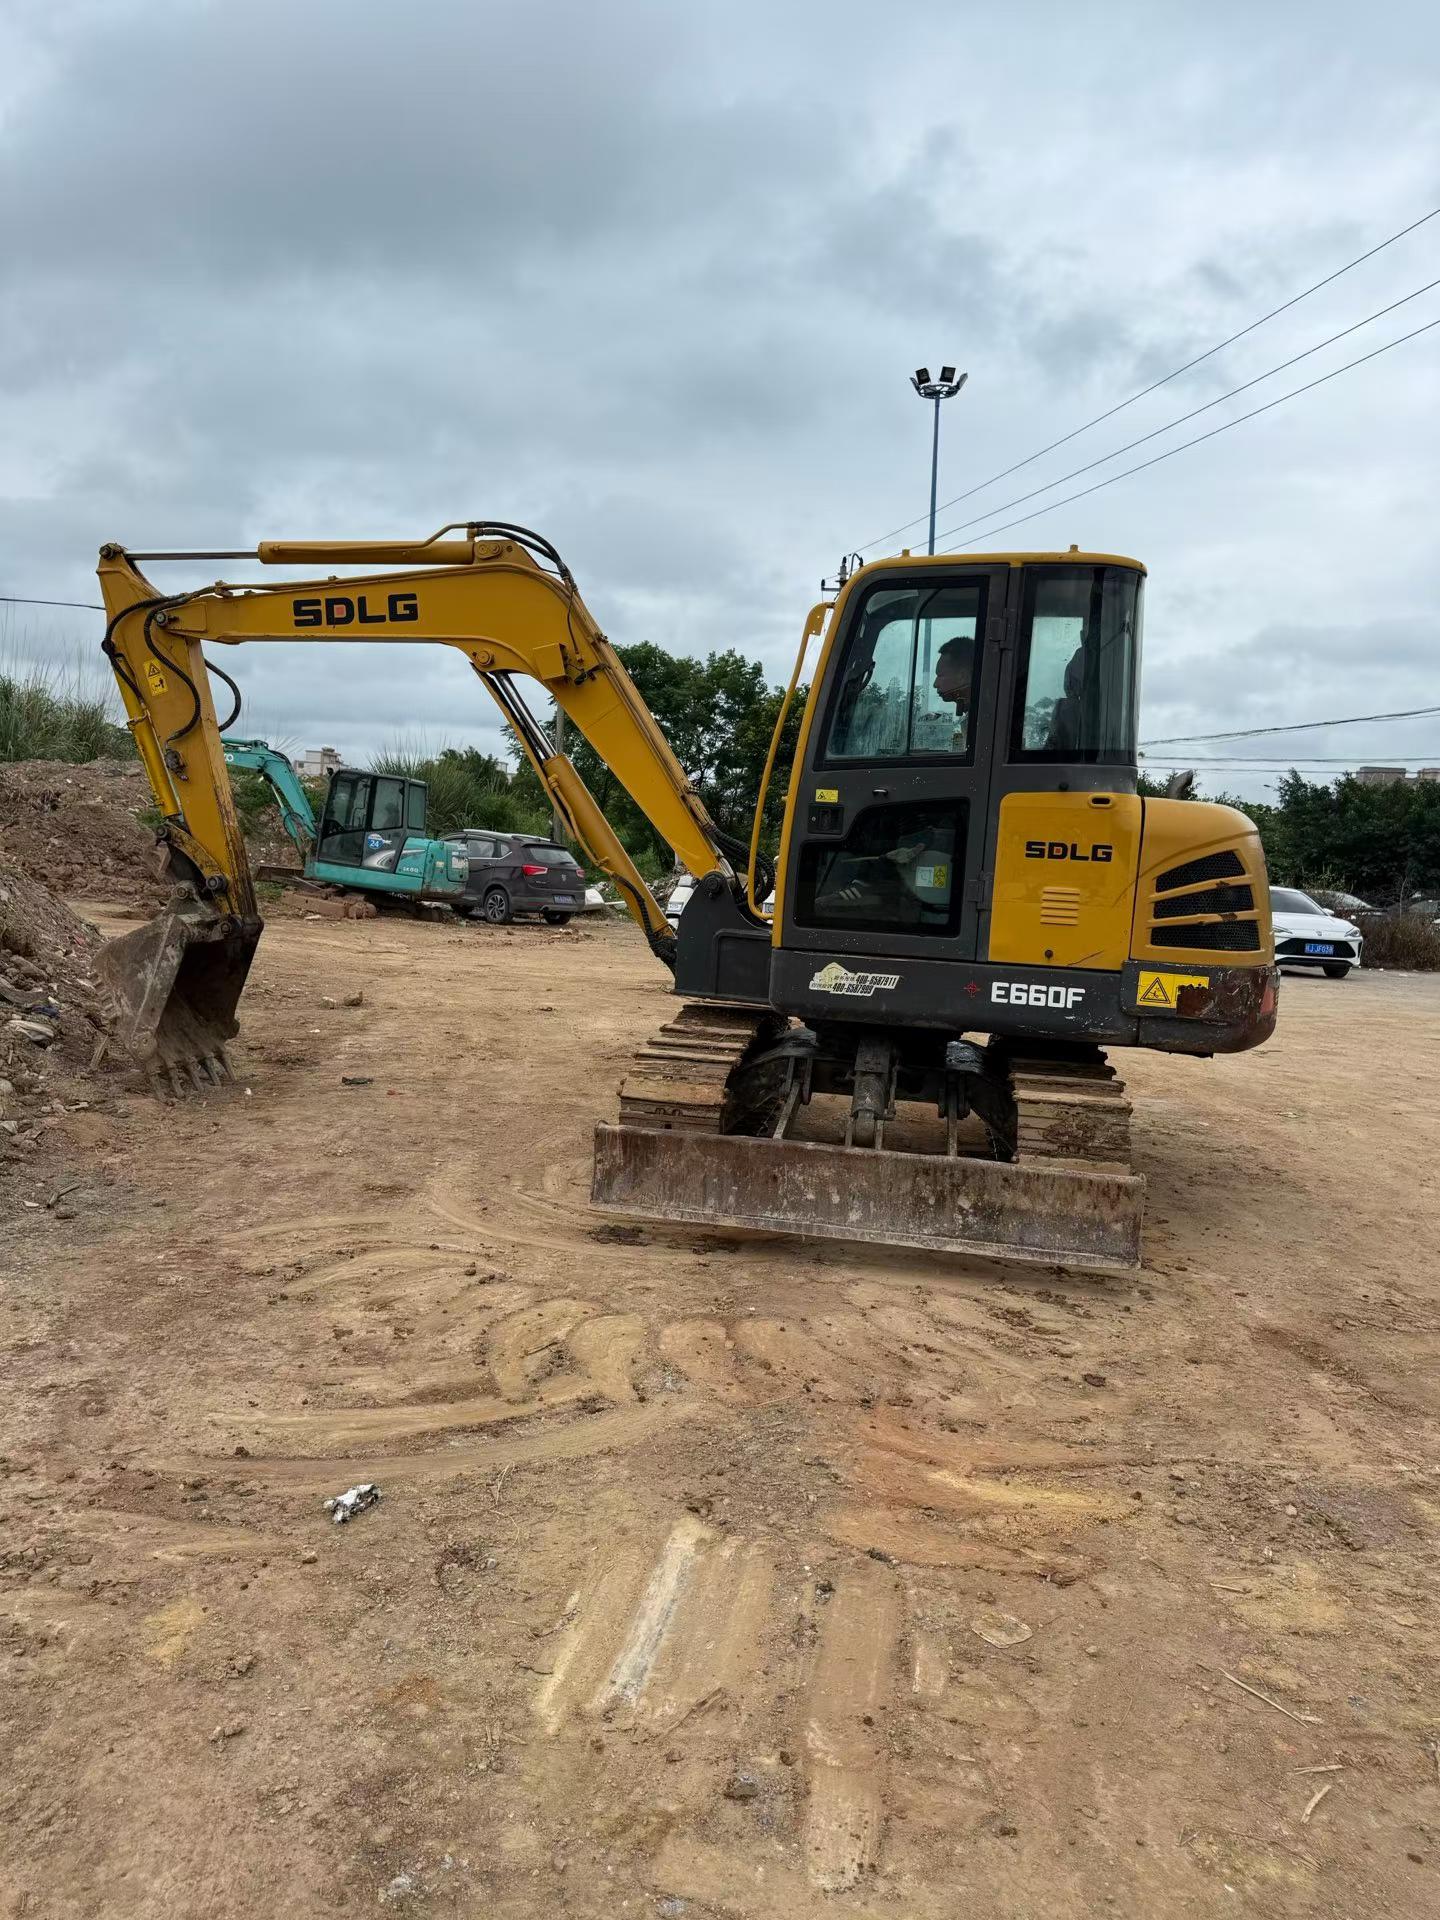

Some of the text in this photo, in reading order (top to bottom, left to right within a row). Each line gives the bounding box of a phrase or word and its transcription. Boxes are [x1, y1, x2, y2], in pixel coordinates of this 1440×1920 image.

[293, 594, 418, 627] SDLG
[370, 840, 379, 848] 24
[1025, 841, 1113, 862] SDLG
[991, 982, 1085, 1008] E660F
